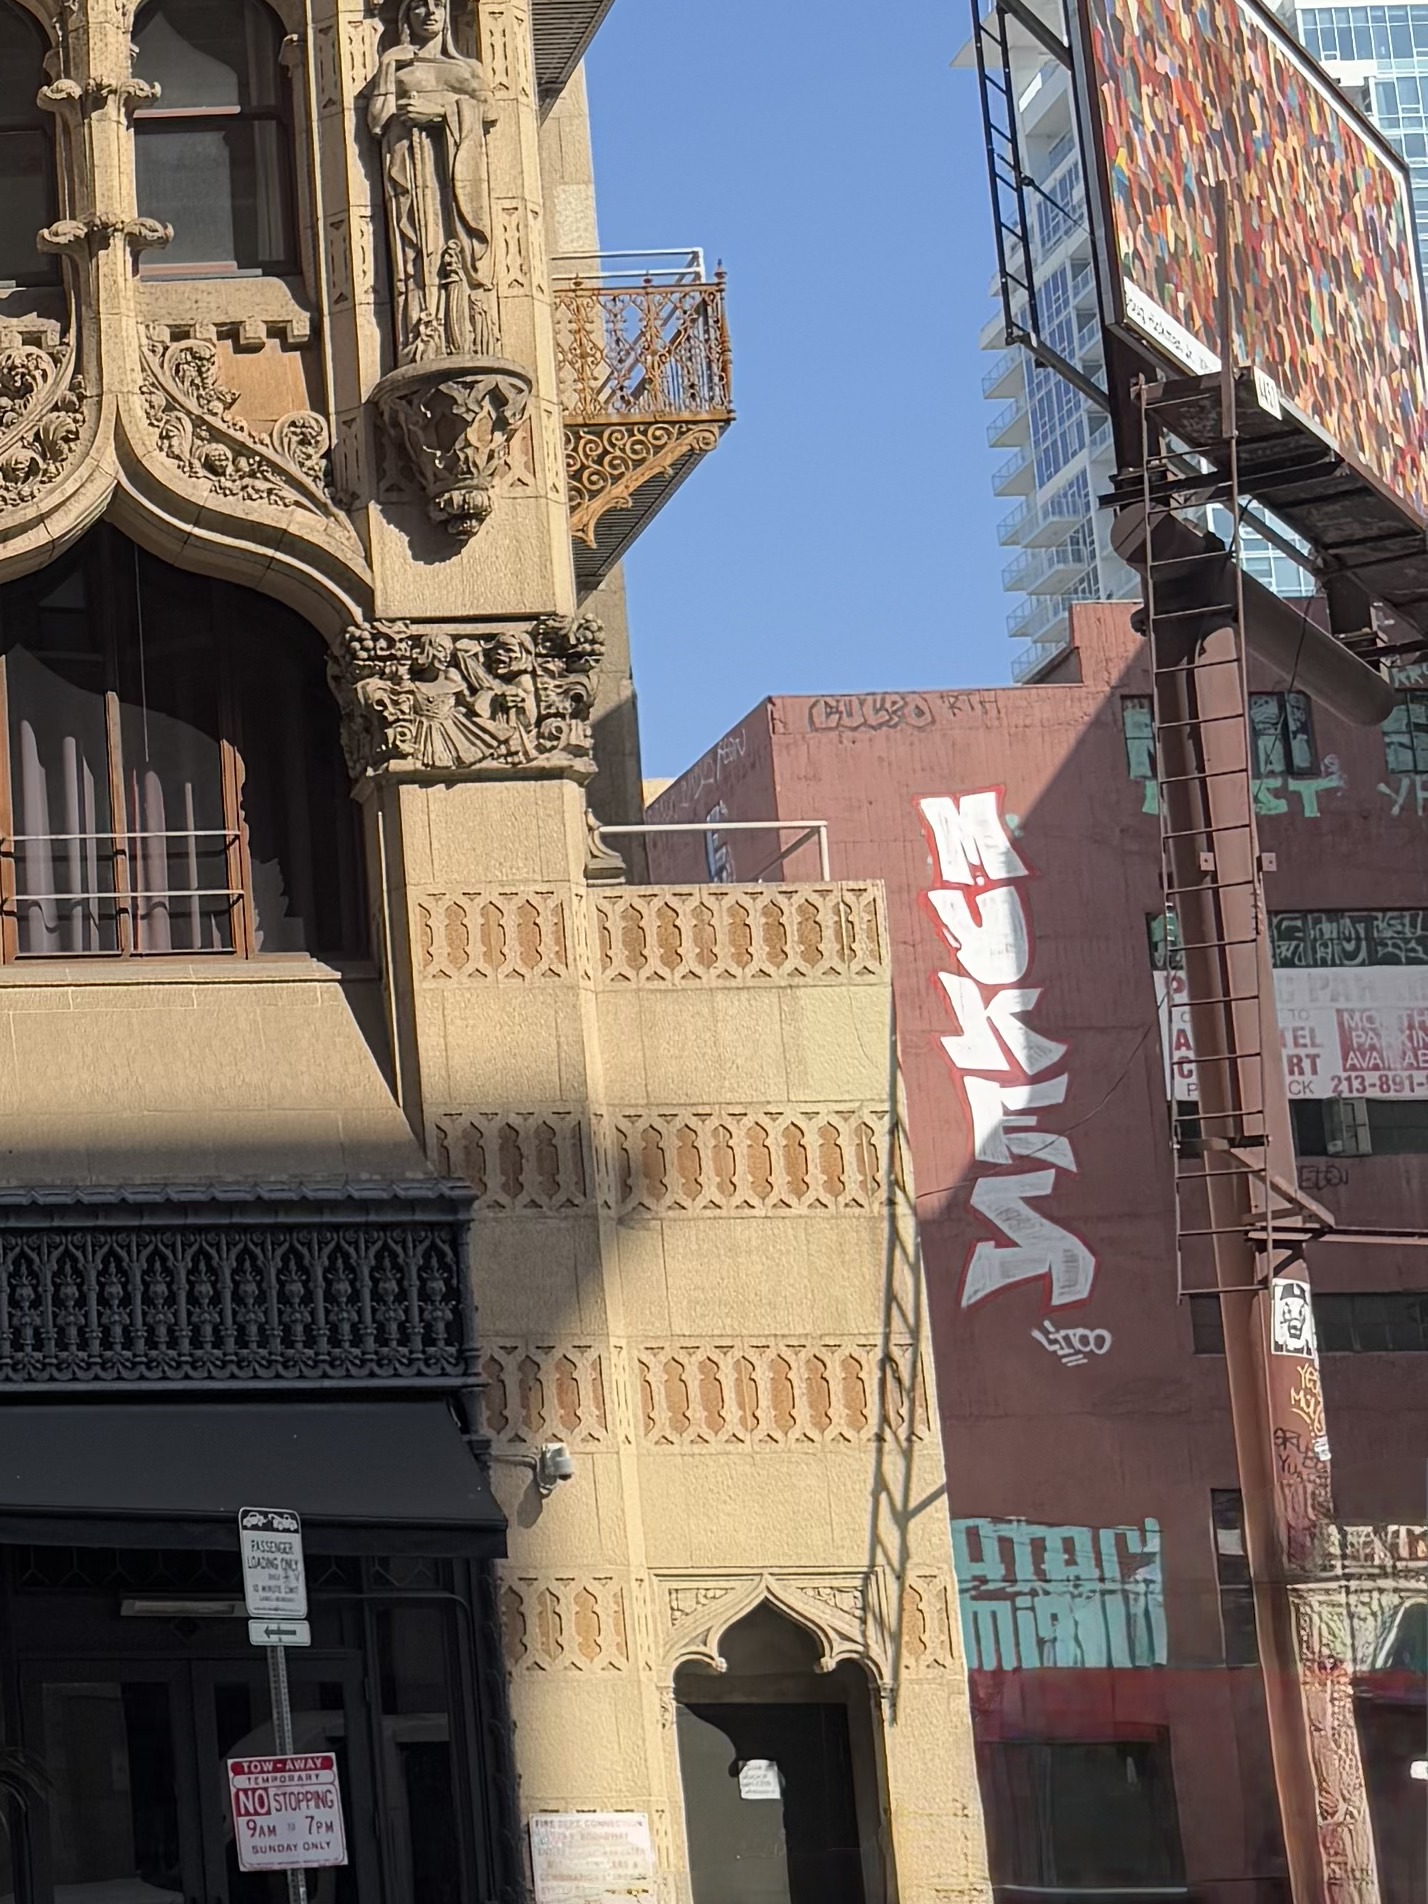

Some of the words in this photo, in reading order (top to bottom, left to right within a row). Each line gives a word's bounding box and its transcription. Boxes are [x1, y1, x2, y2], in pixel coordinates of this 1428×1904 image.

[1330, 1073, 1428, 1096] 213-891-
[247, 1773, 320, 1785] TEMPORARY
[238, 1788, 269, 1815] NO
[273, 1789, 335, 1813] STOPPING
[252, 1843, 298, 1855] SUNDAY
[302, 1840, 331, 1851] ONLY
